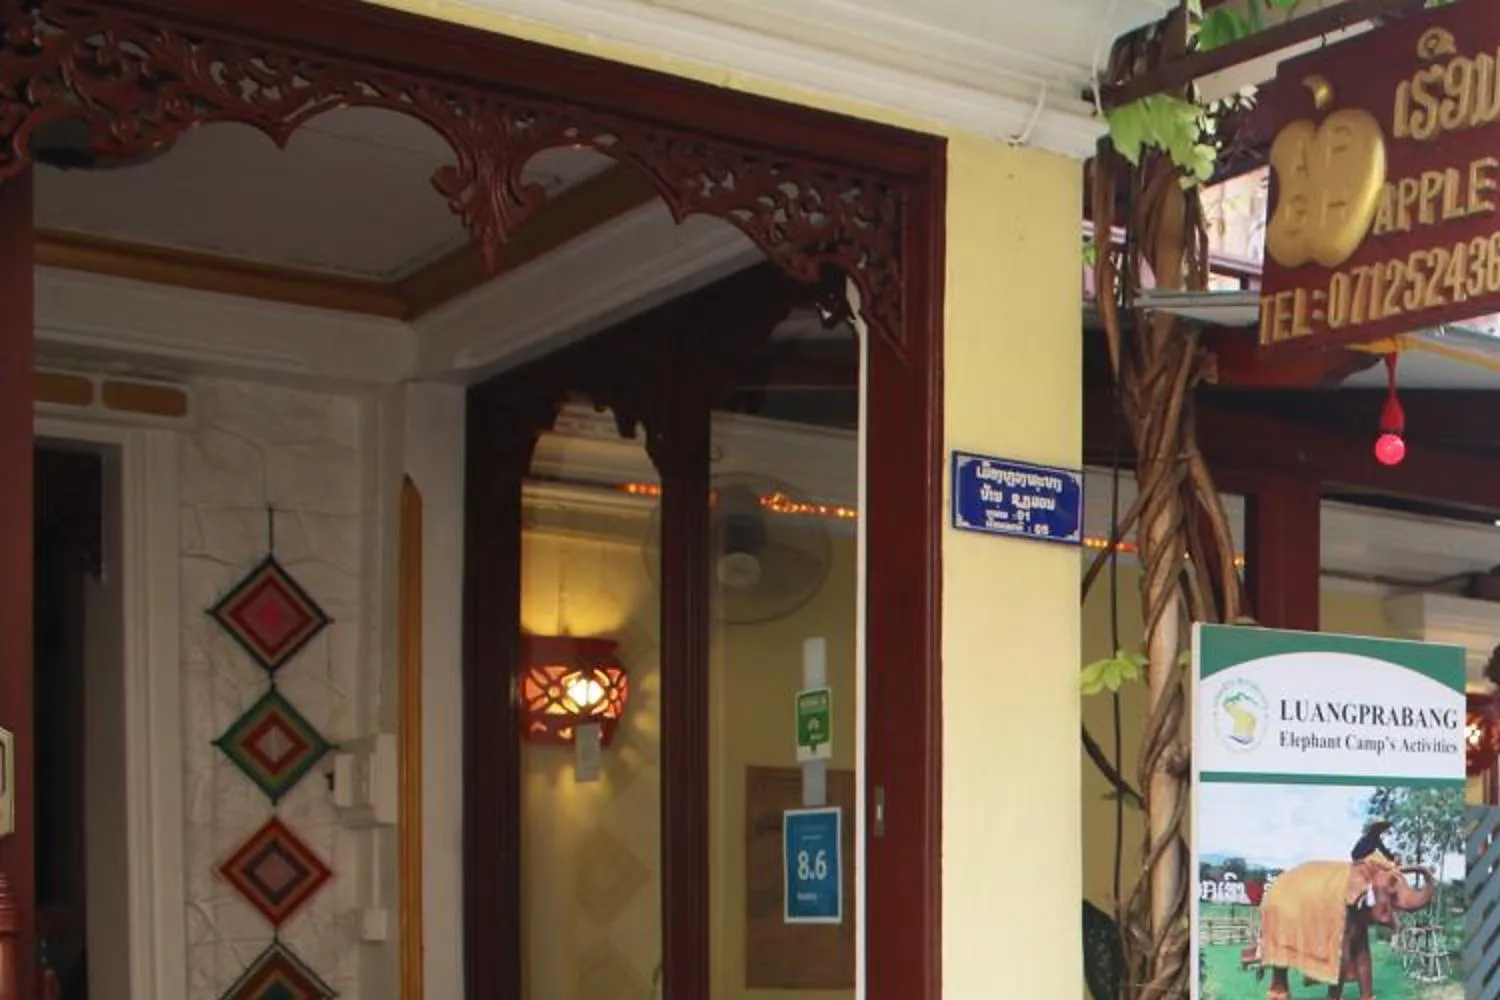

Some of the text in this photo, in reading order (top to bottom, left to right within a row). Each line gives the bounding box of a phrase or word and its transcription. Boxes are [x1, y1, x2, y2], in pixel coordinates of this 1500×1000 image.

[1374, 156, 1499, 236] APPLE
[1280, 699, 1457, 730] LUANGPRABANG
[1280, 731, 1341, 754] Elephant
[1400, 737, 1458, 753] Activities
[797, 849, 827, 880] 8.6
